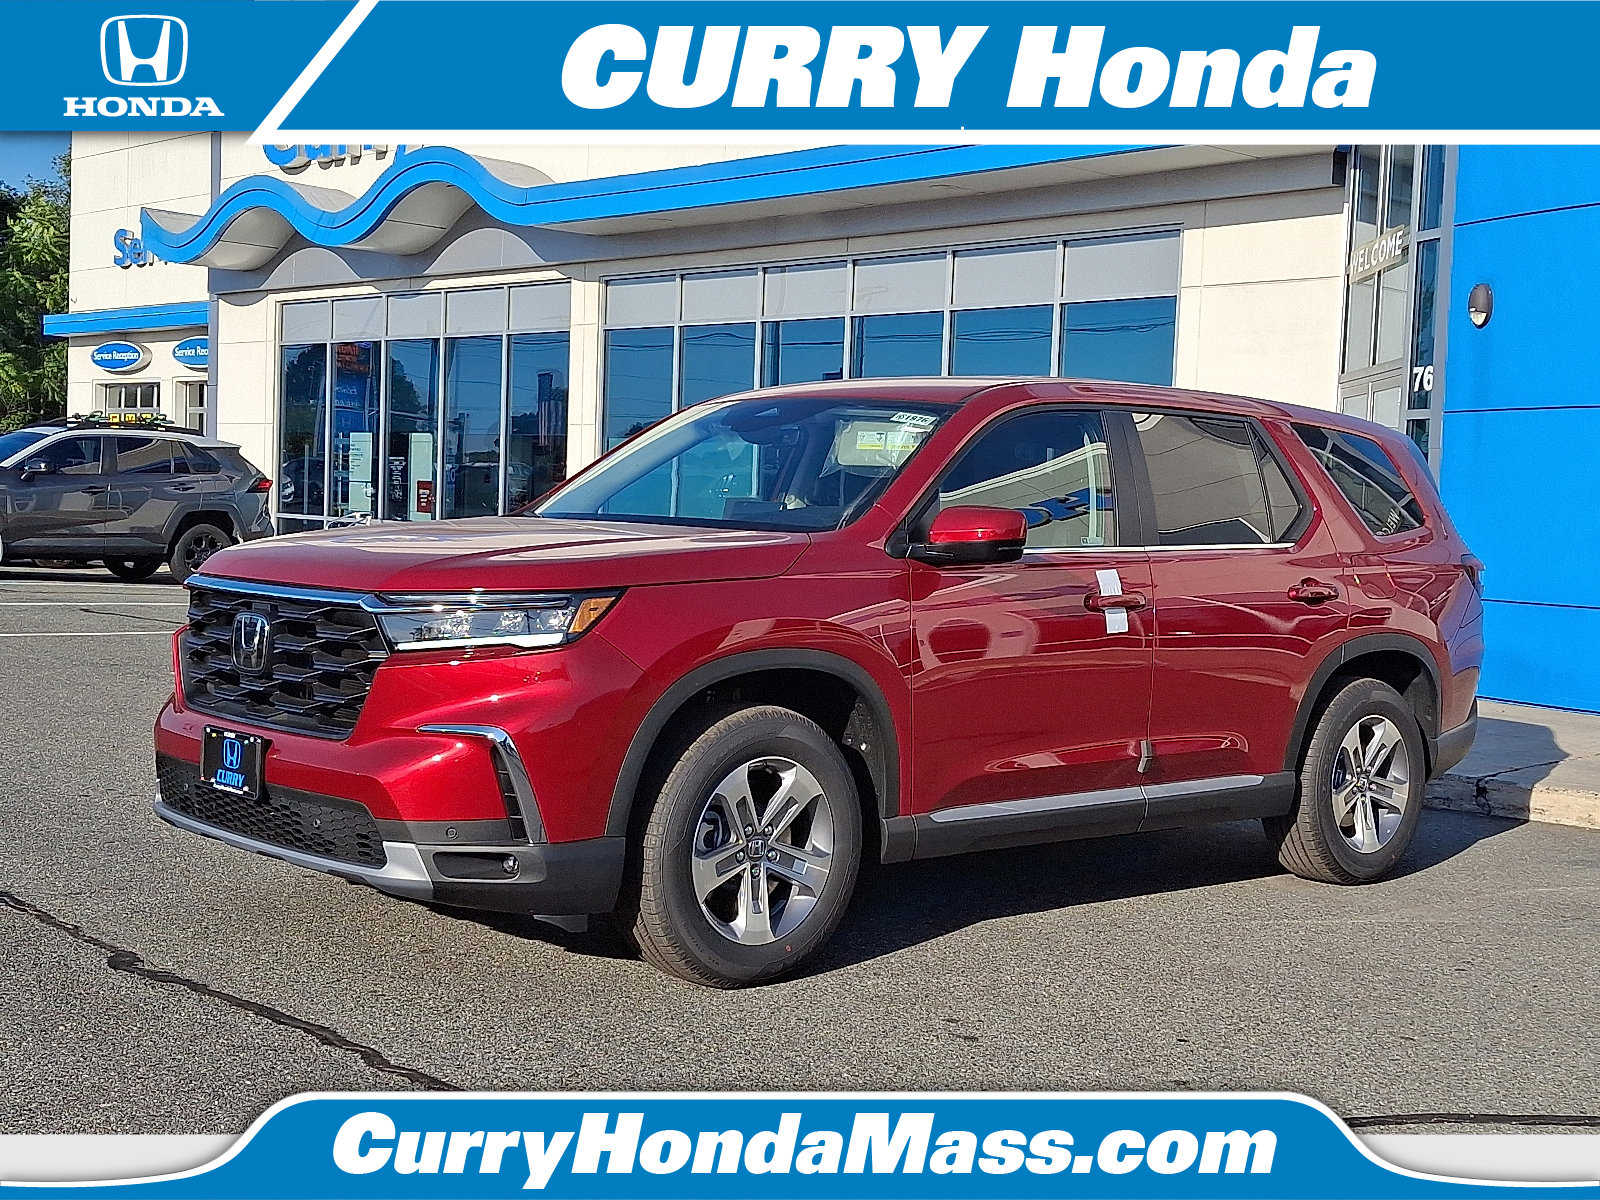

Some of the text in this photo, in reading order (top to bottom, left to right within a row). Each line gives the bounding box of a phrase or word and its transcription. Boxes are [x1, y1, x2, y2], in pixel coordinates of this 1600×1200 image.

[1350, 230, 1404, 276] WELCOME
[93, 351, 138, 362] Service Reception
[175, 347, 195, 357] Service
[1412, 365, 1435, 392] 76
[217, 769, 244, 787] CURRY
